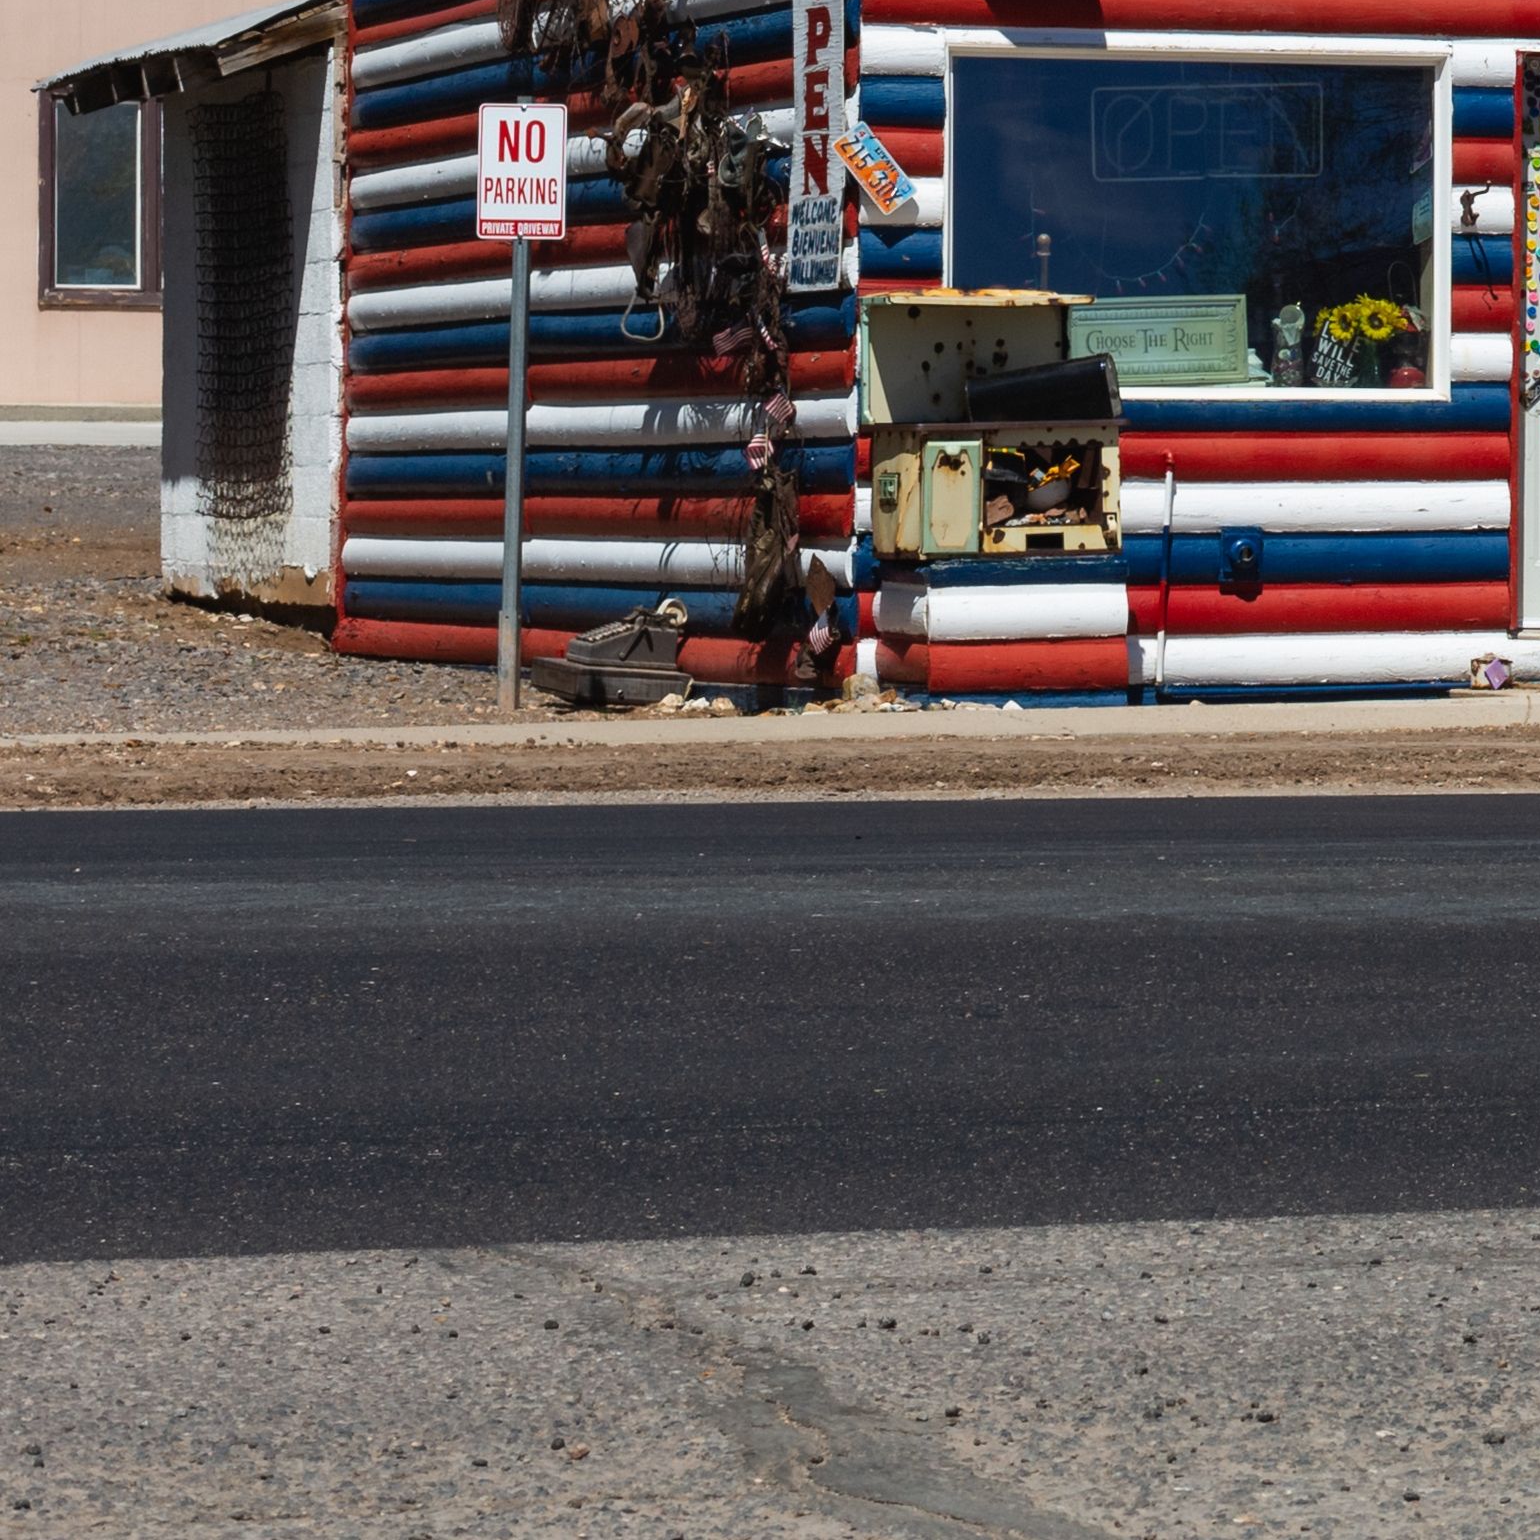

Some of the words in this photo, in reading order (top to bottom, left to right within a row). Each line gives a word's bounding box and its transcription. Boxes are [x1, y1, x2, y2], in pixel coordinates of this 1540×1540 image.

[498, 119, 546, 164] NO
[840, 134, 875, 171] Z15
[875, 147, 897, 172] UTAH
[484, 176, 558, 205] PARKING
[792, 198, 838, 226] WELCOME
[481, 221, 515, 235] PRIVATE
[517, 222, 560, 236] DRIVEWAY
[1311, 351, 1336, 371] SAVE
[1335, 362, 1353, 379] THE
[1318, 337, 1355, 368] WILL
